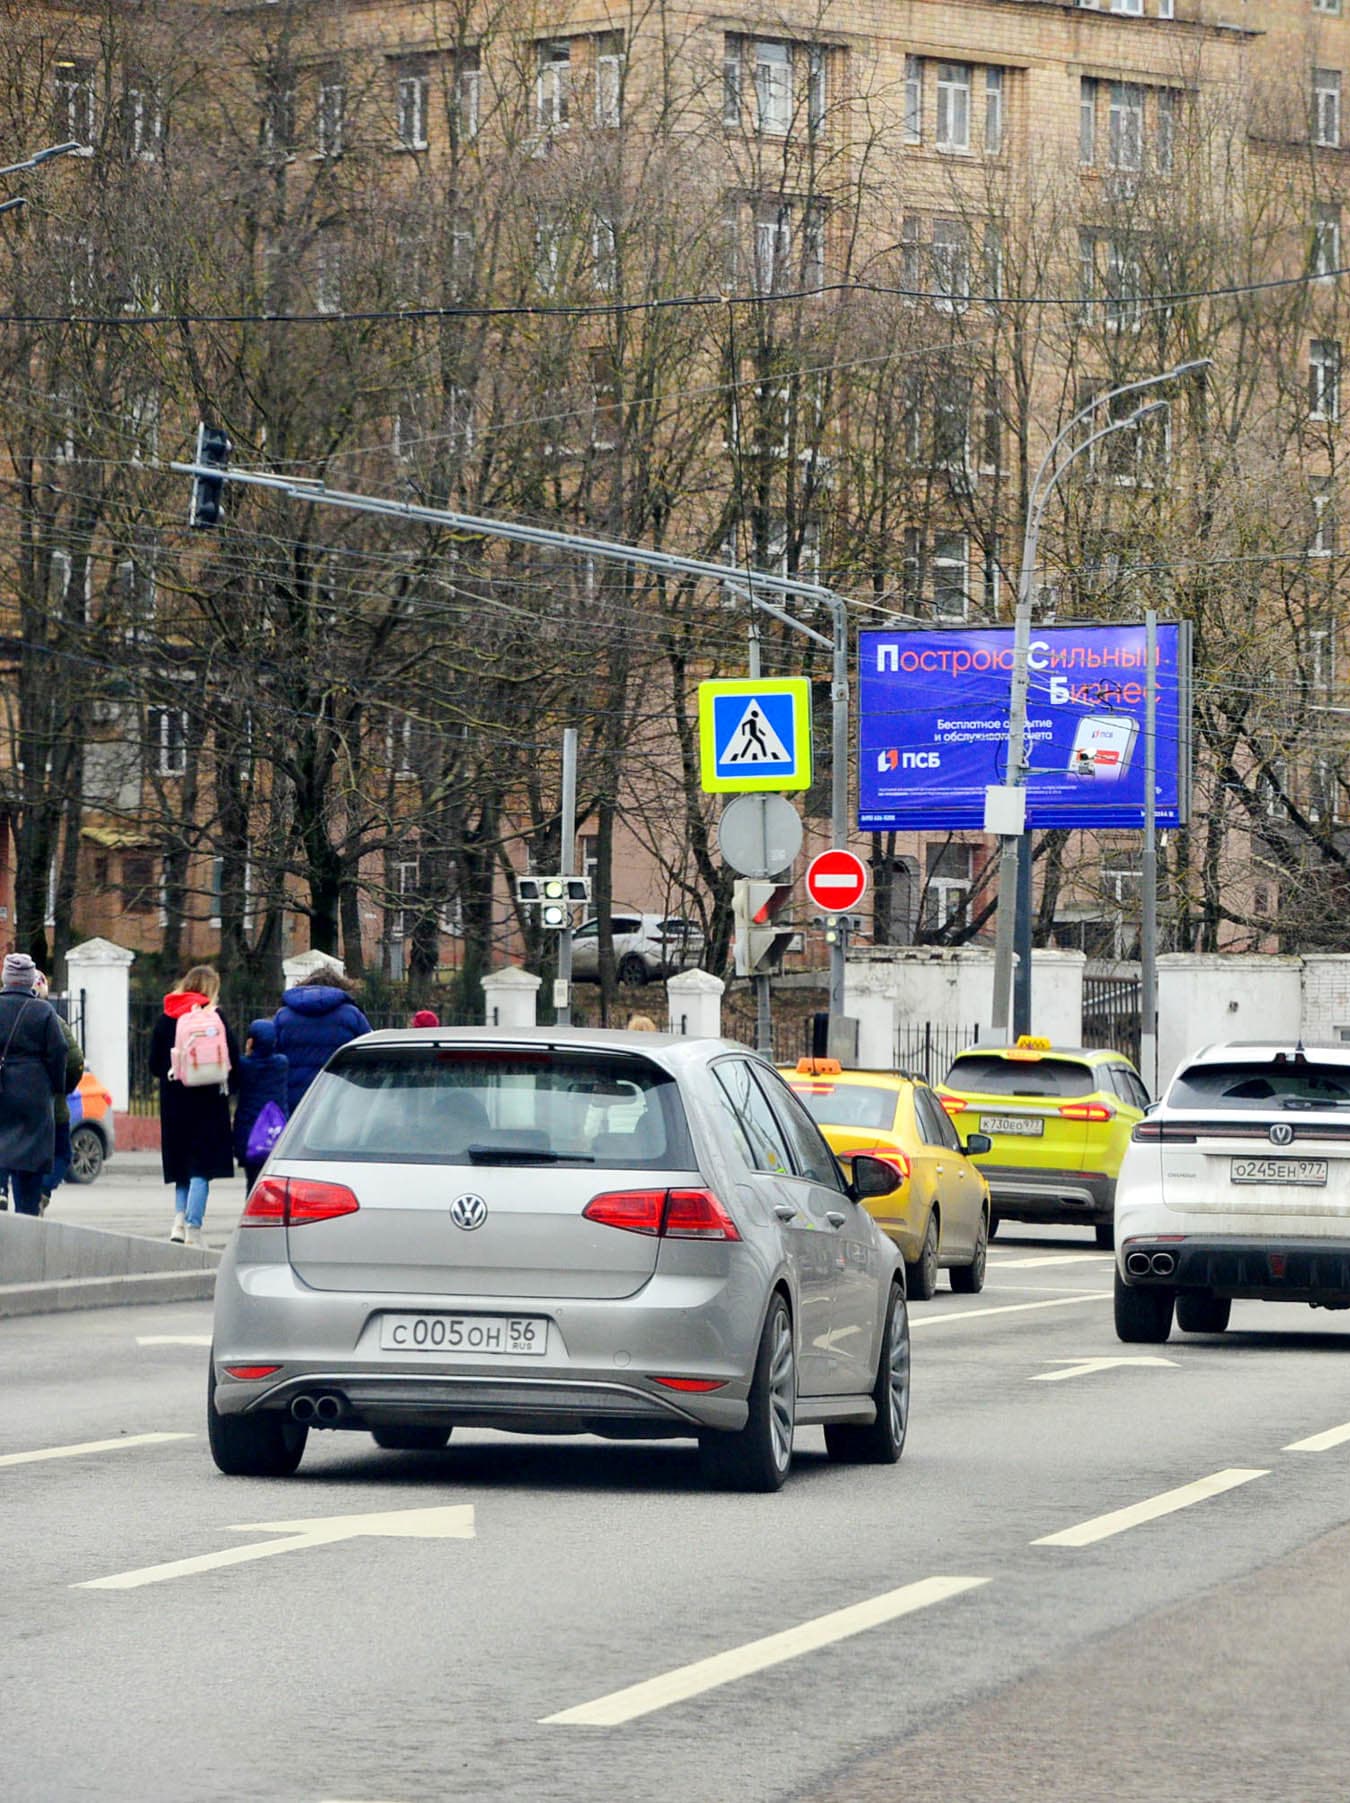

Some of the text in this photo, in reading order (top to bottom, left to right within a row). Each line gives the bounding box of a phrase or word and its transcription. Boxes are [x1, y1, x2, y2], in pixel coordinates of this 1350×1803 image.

[877, 644, 1016, 678] Построю
[937, 719, 1053, 730] Бесплатное орытие
[934, 733, 941, 742] и
[902, 752, 941, 769] ПСБ
[392, 1319, 536, 1347] С005ОН 56
[512, 1342, 533, 1351] RUS
